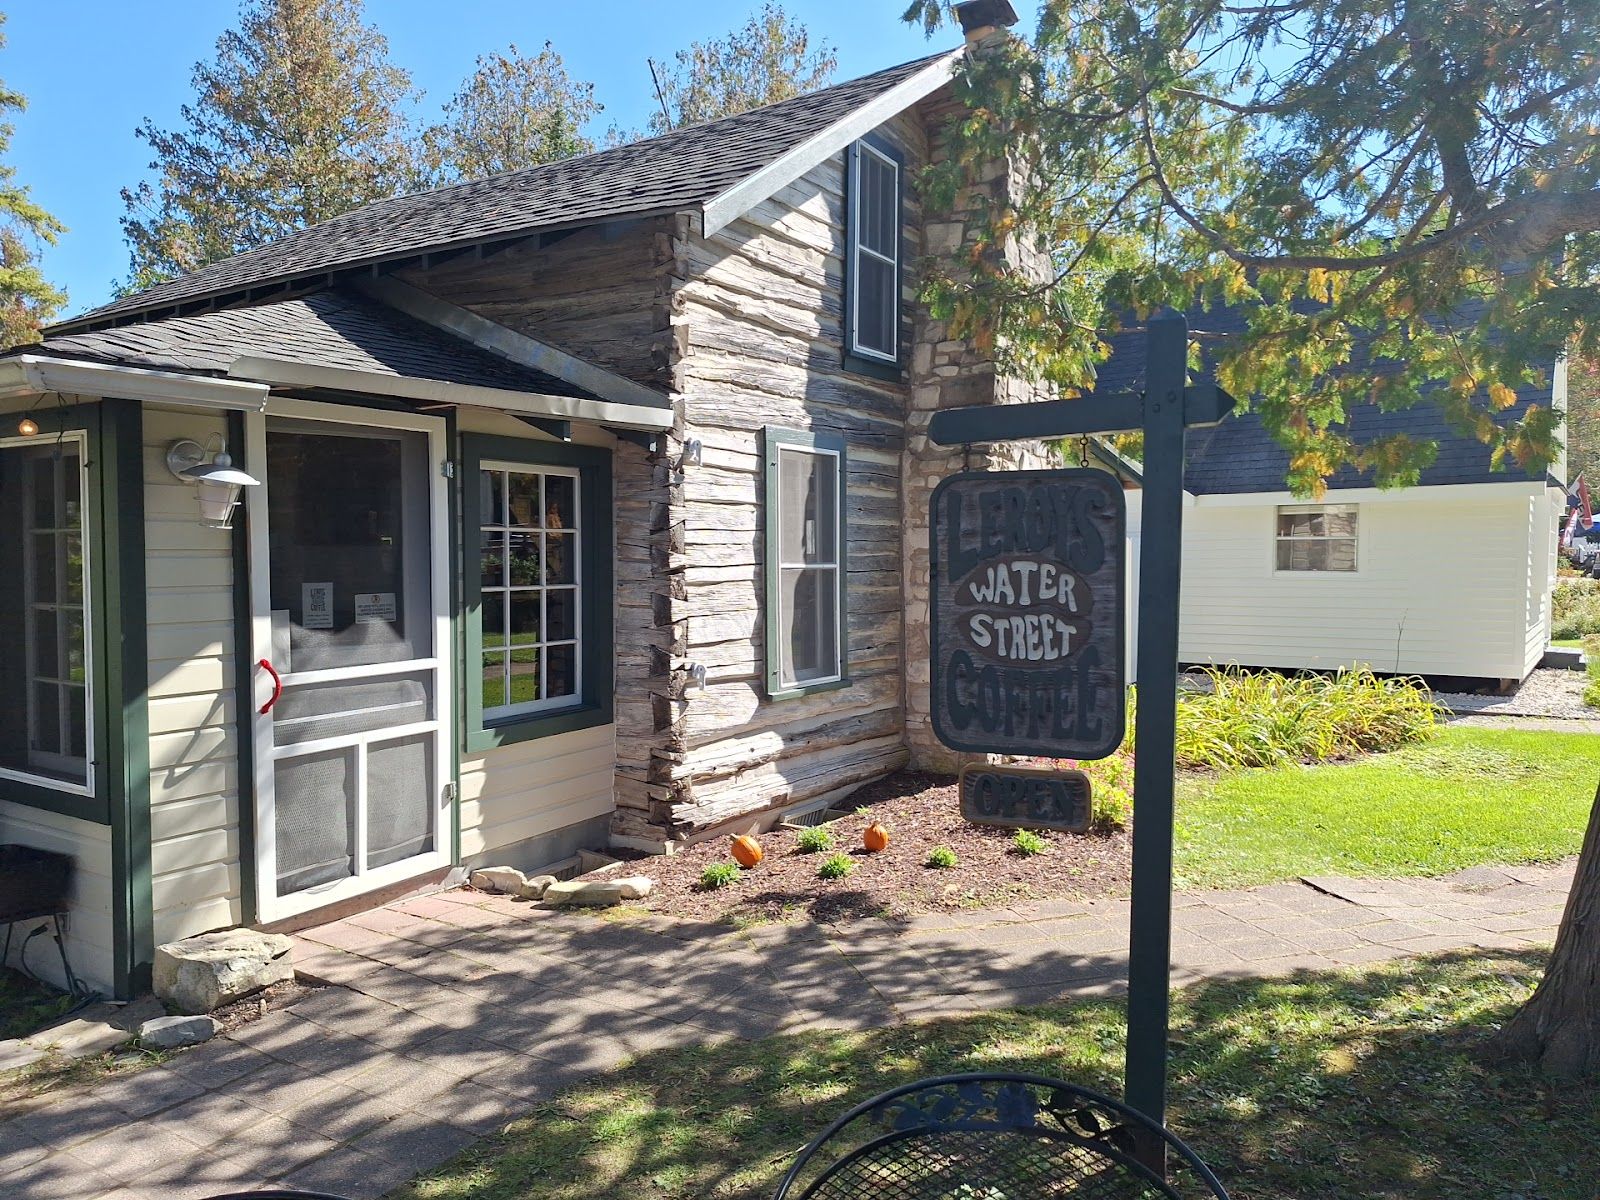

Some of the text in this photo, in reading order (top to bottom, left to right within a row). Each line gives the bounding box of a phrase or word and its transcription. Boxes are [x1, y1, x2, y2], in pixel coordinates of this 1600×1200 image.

[969, 560, 1077, 612] WATER
[969, 613, 1077, 661] STREET
[947, 646, 1102, 741] COFFEE
[974, 774, 1075, 822] OPEN
